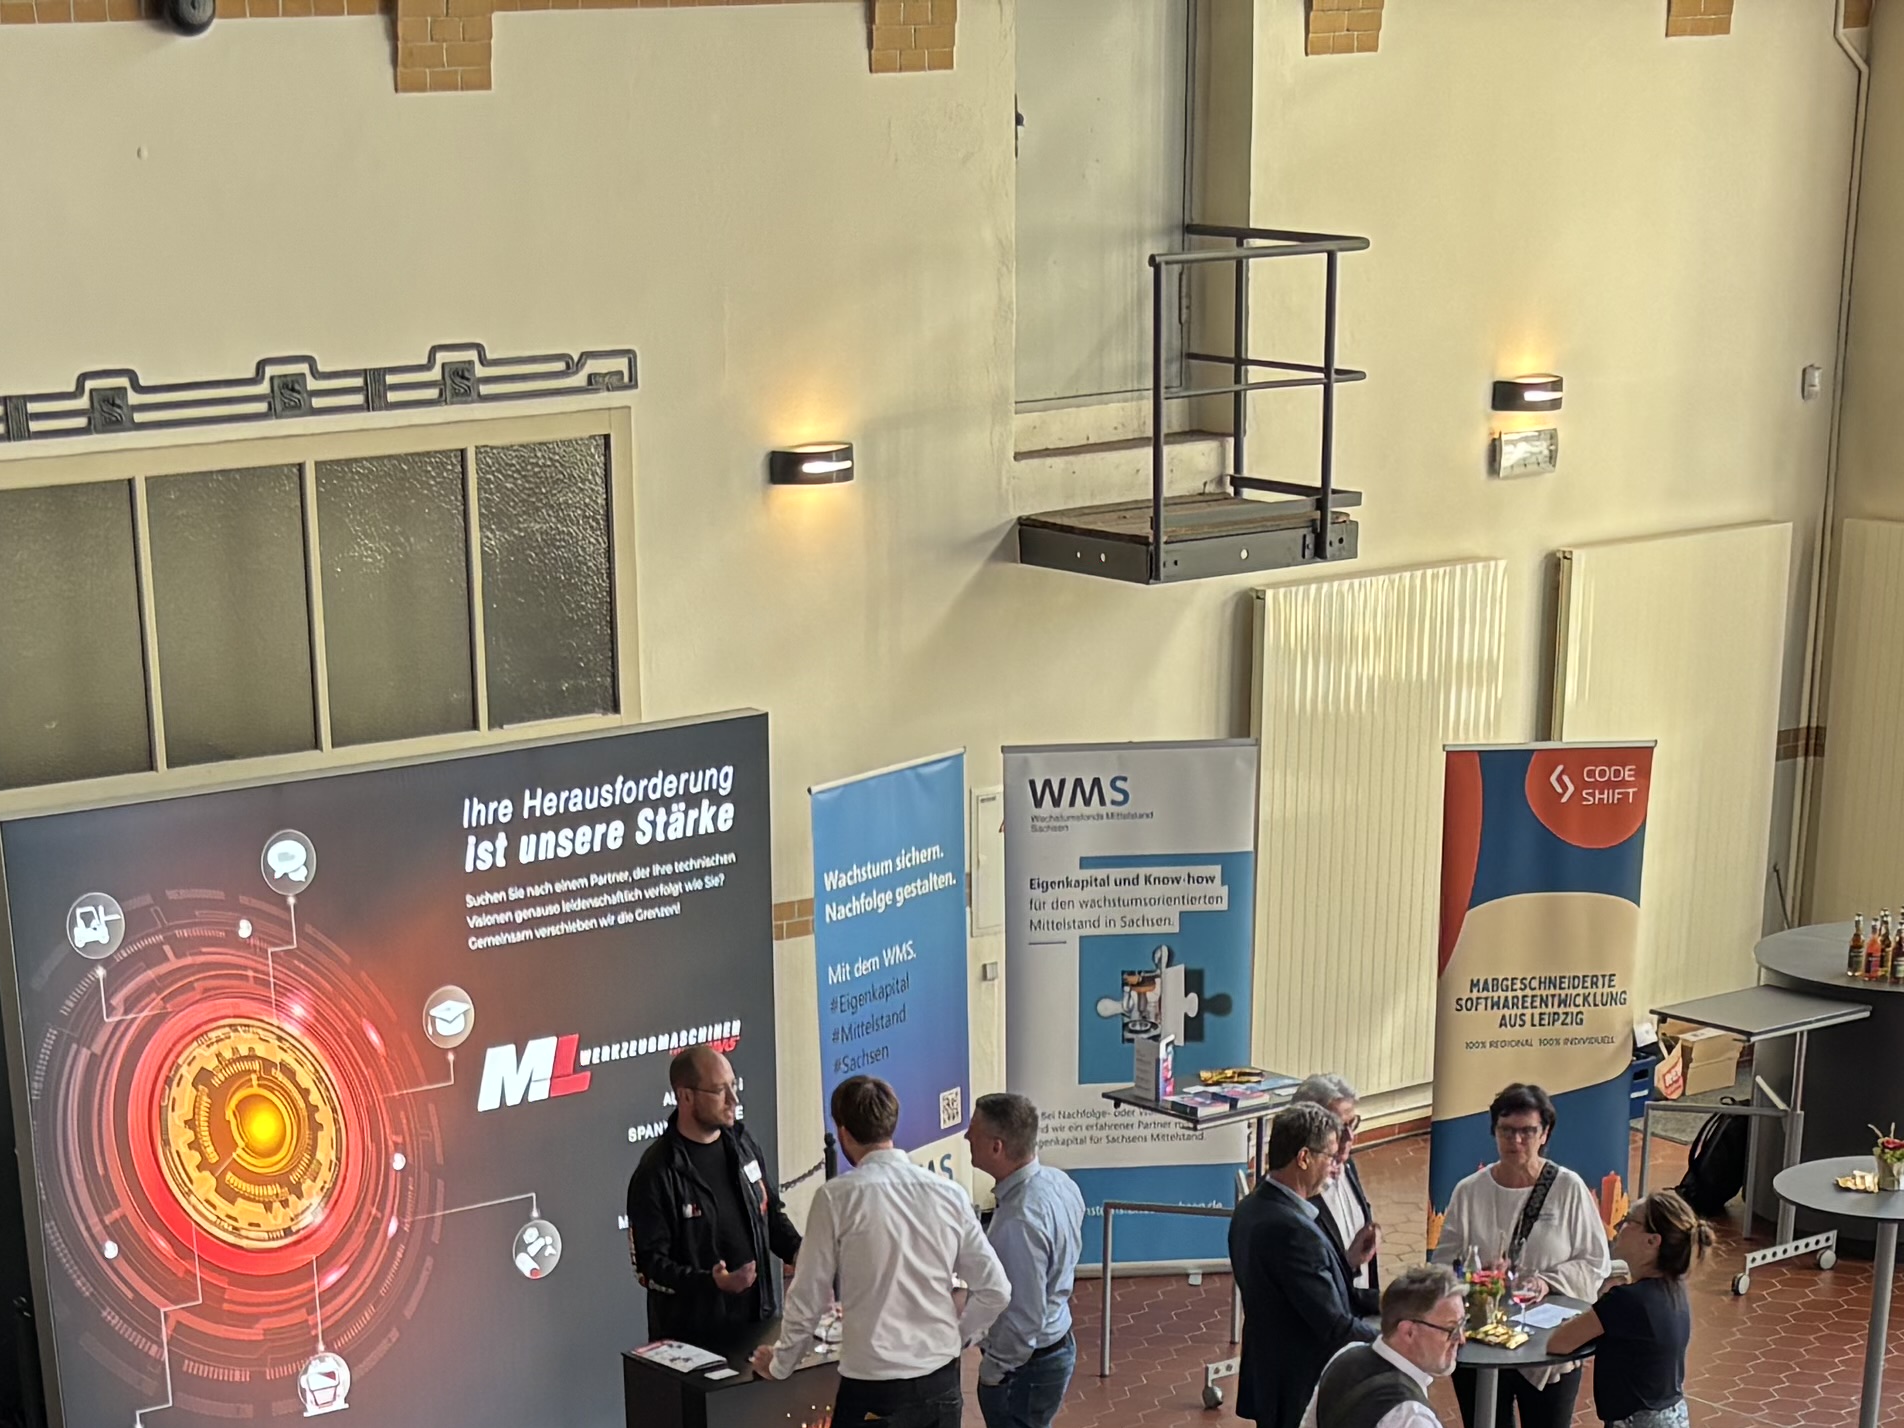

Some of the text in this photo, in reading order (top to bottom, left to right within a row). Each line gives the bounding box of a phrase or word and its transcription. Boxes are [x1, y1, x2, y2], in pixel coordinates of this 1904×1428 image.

[1582, 765, 1636, 783] CODE
[462, 765, 734, 828] Ihre Herausforderung
[1028, 775, 1131, 809] WMS
[1582, 788, 1638, 805] SHIFT
[465, 799, 734, 872] ist unsere Stärke
[465, 852, 736, 908] Suchen Sie nach einem Partner, der Ihre technischen
[824, 844, 944, 892] Wachstum sichern.
[1029, 872, 1216, 893] Eigenkapital und Know-how
[515, 904, 560, 923] genauso
[562, 886, 642, 914] leidenschaftlich
[645, 880, 683, 900] verfolgt
[685, 878, 703, 893] wie
[705, 872, 726, 889] Sie?
[825, 871, 957, 924] Nachfolge gestalten.
[1029, 893, 1224, 911] für den wachstumsorientierten
[468, 927, 534, 950] Gemeinsam
[534, 915, 598, 938] verschieben
[599, 910, 615, 927] wir
[617, 908, 634, 924] die
[1029, 913, 1175, 932] Mittelstand in Sachsen.
[828, 940, 917, 985] Mit dem WMS.
[830, 971, 910, 1015] #Eigenkapital
[1455, 990, 1628, 1012] SOFTWAREENTWICKLUNG
[832, 1003, 907, 1044] #Mittelstand
[1499, 1011, 1584, 1029] AUS LEIPZIG
[1465, 1040, 1486, 1050] 100%
[1539, 1037, 1561, 1047] 100%
[477, 1032, 591, 1112] ML
[834, 1045, 889, 1074] #Sachsen
[1041, 1110, 1055, 1121] Bei
[1114, 1107, 1136, 1118] oder
[1051, 1124, 1066, 1133] wir
[1068, 1123, 1083, 1133] ein
[1085, 1121, 1135, 1132] erfahrener
[1137, 1120, 1173, 1131] Partner
[1089, 1134, 1103, 1146] für
[1106, 1132, 1148, 1144] Sachsens
